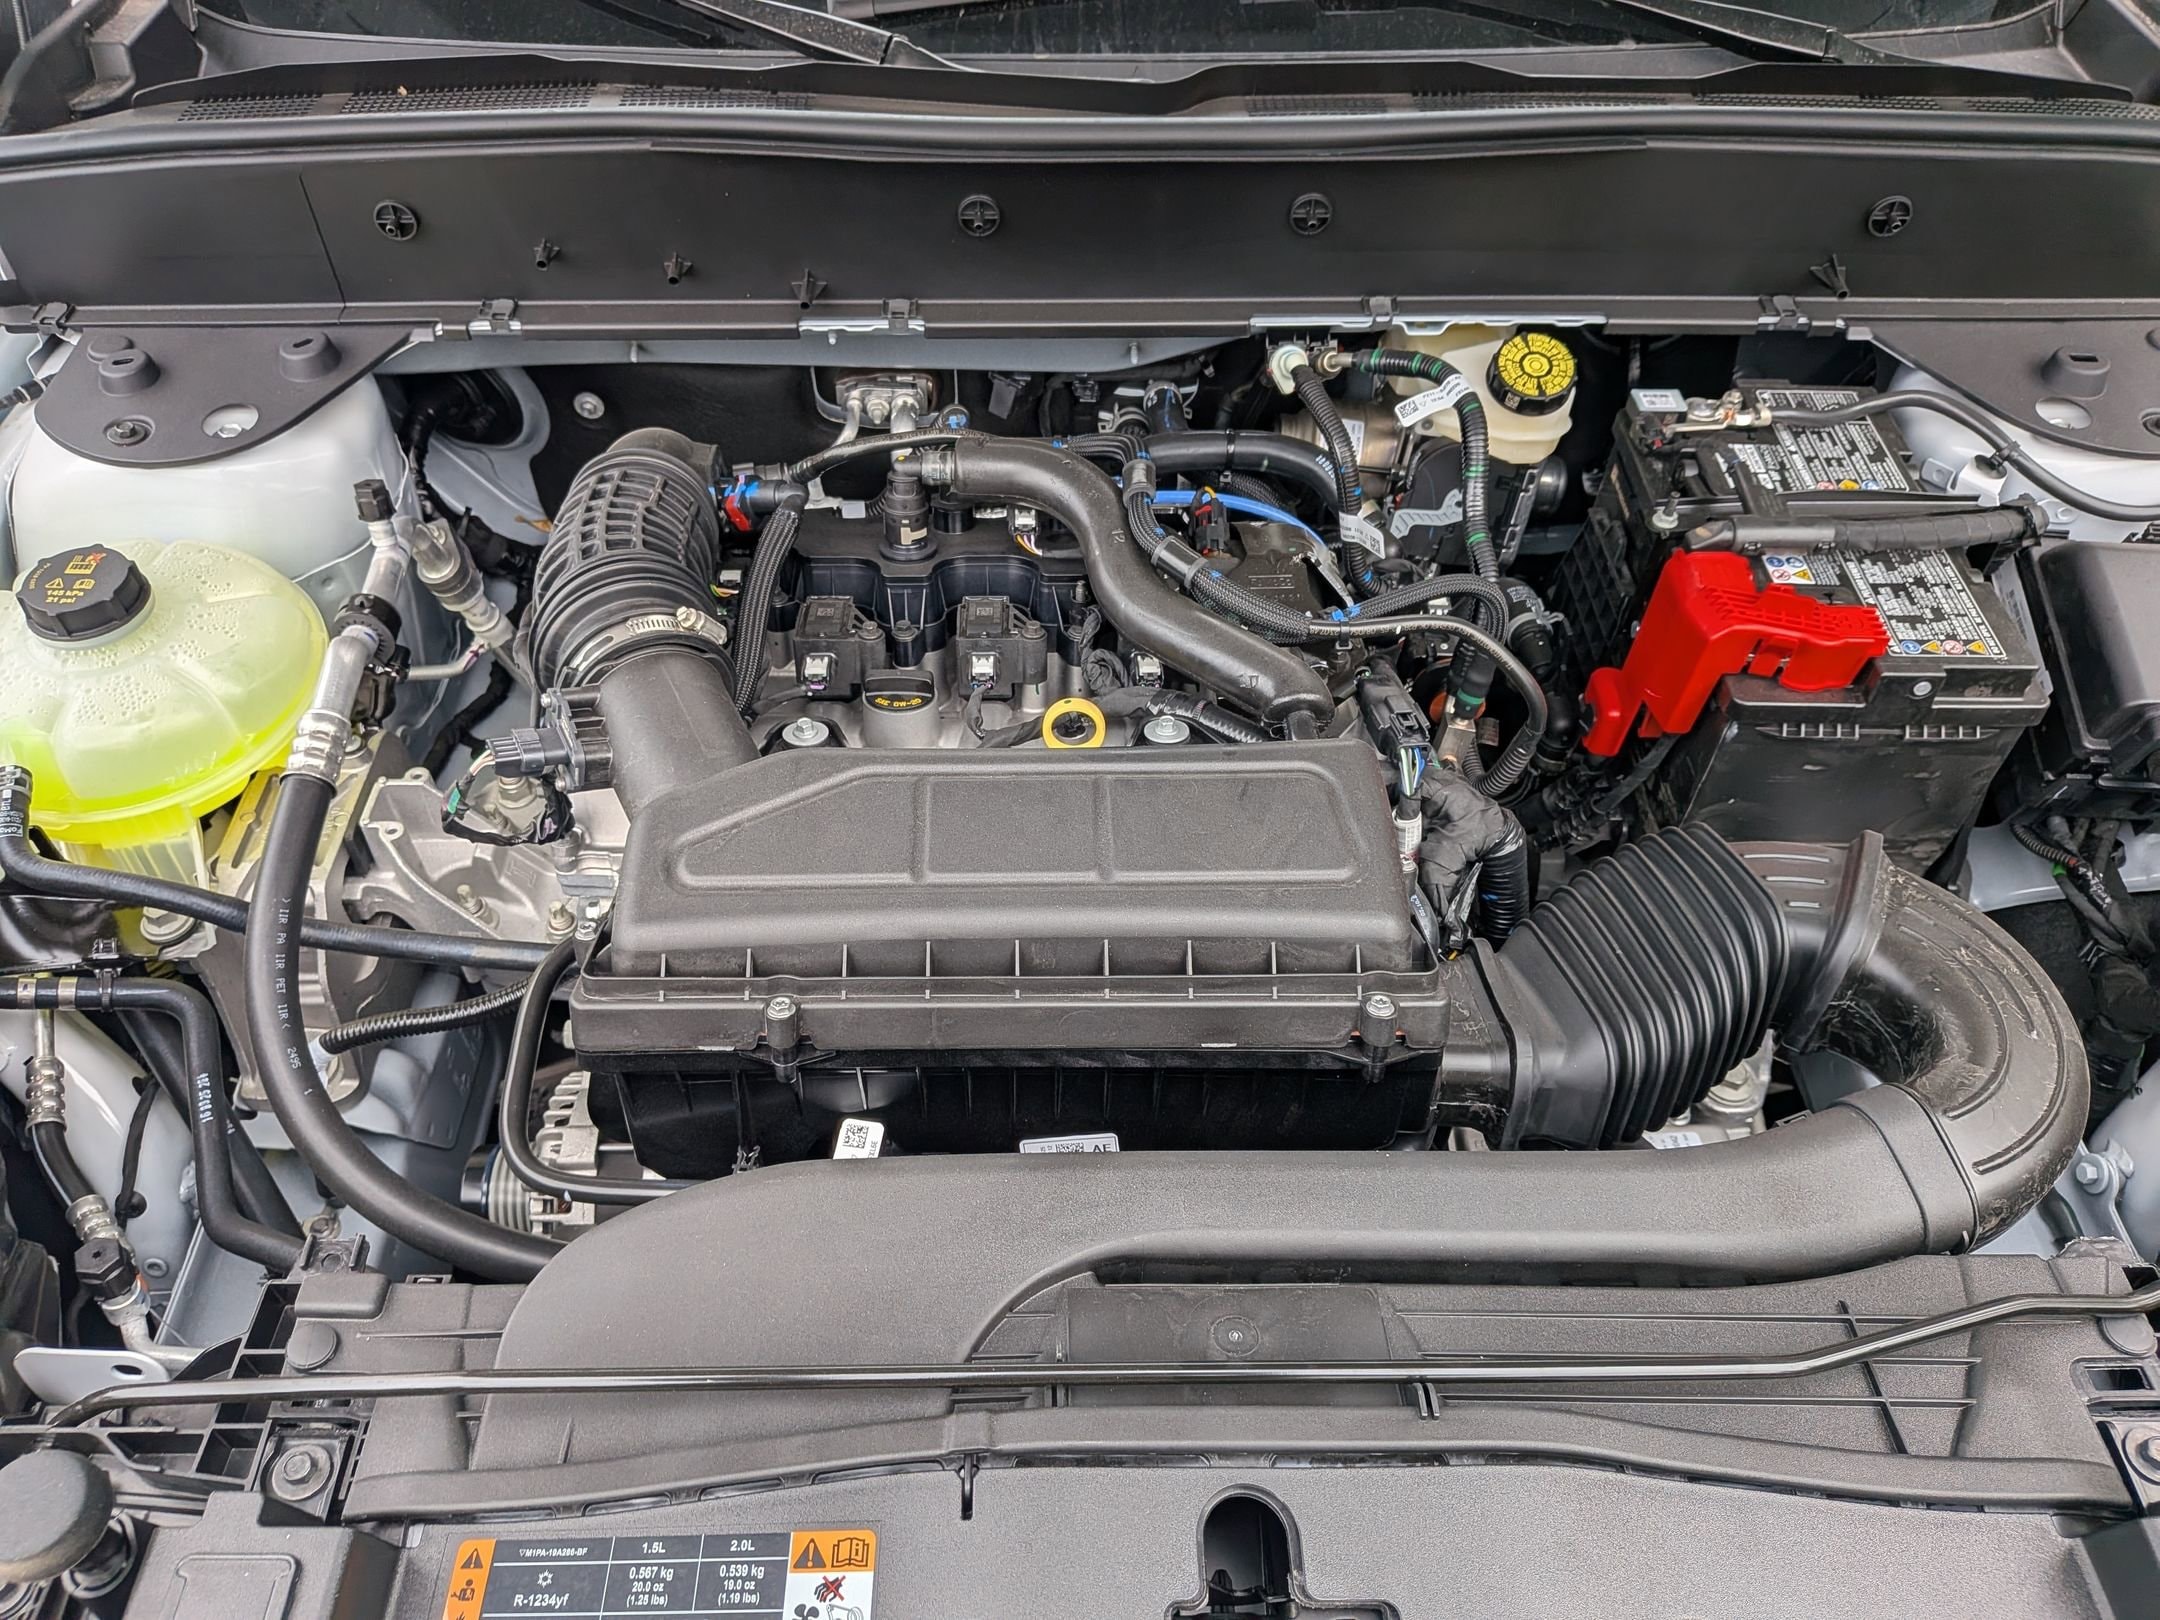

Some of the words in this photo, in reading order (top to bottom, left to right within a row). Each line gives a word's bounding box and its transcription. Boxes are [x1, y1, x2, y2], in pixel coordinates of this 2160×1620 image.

[276, 932, 287, 945] PA
[275, 977, 287, 995] PET
[641, 1541, 666, 1554] 1.5L
[729, 1539, 756, 1552] 2.0L
[629, 1566, 659, 1580] 0.567
[660, 1566, 674, 1581] kg
[719, 1564, 748, 1577] 0.539
[750, 1564, 765, 1579] kg
[631, 1581, 652, 1593] 20.0
[652, 1583, 665, 1592] oz
[722, 1579, 742, 1591] 19.0
[743, 1581, 756, 1590] oz
[513, 1593, 569, 1609] R-1234yf
[650, 1594, 668, 1607] lbs)
[742, 1592, 760, 1606] lbs)
